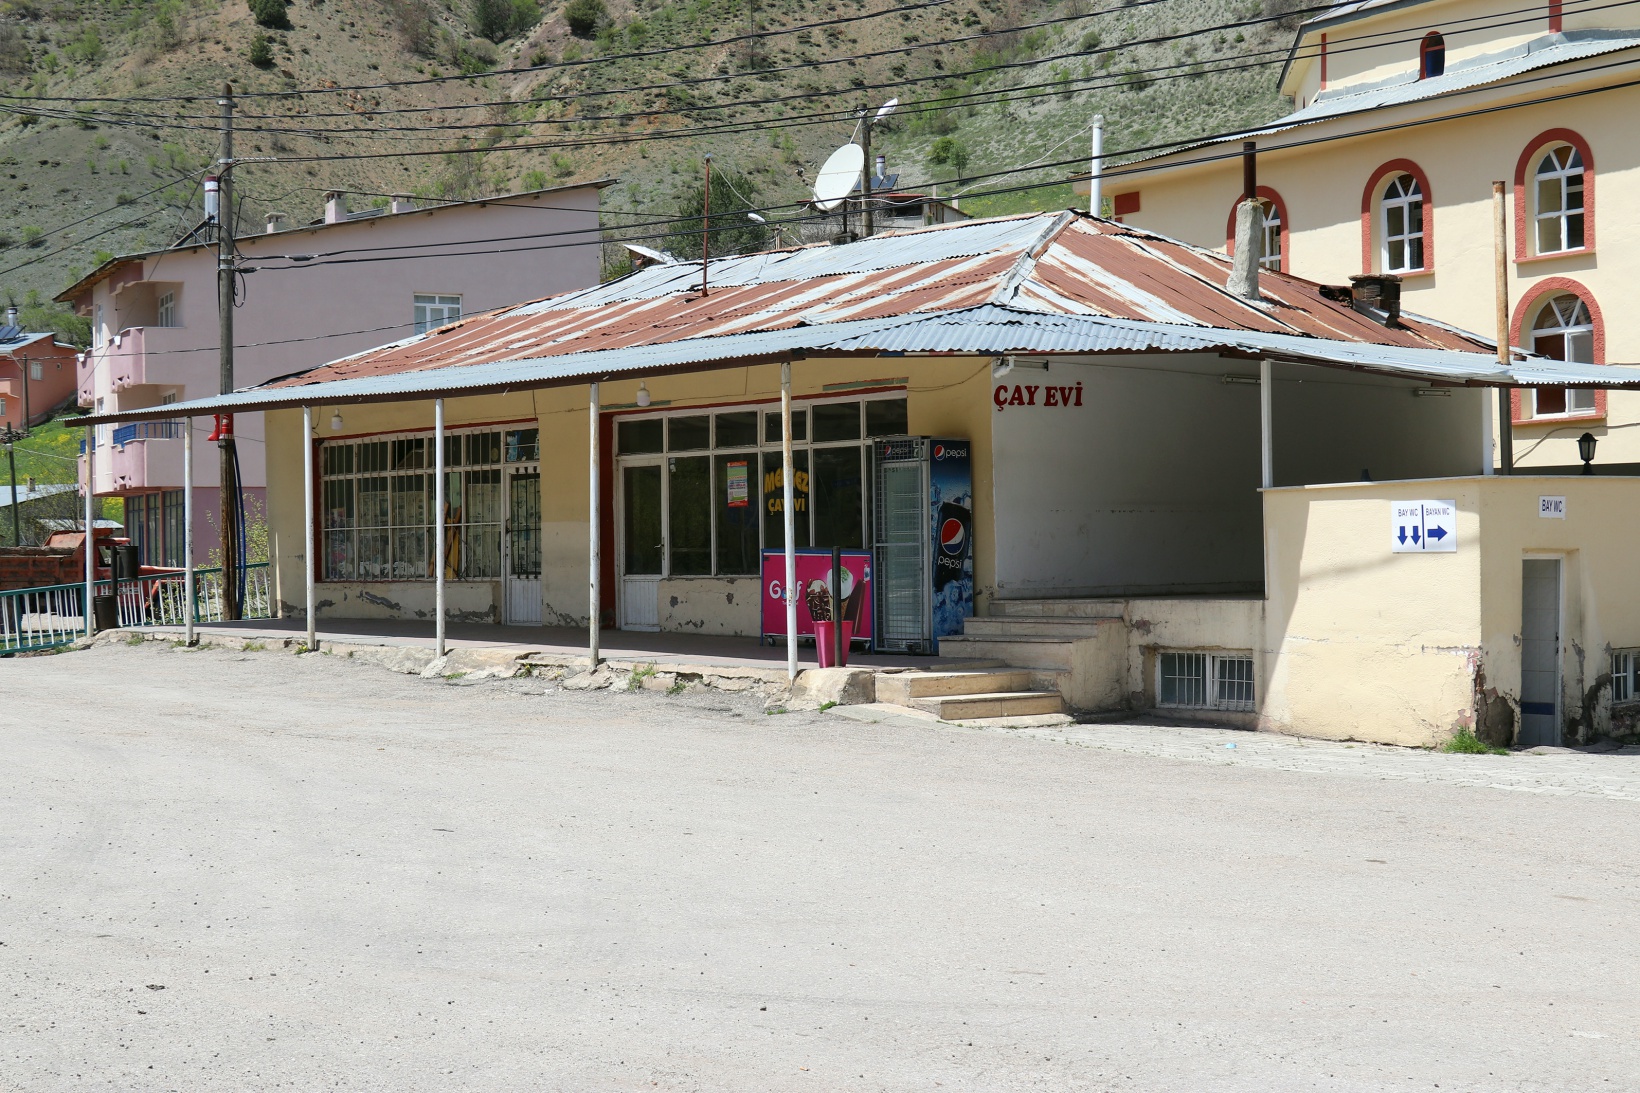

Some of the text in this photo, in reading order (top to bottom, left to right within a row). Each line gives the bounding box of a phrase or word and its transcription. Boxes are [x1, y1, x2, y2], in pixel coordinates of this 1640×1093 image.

[993, 381, 1083, 412] ÇAY EVİ
[945, 448, 967, 459] pepsi
[764, 467, 809, 494] MEEZ
[1397, 508, 1419, 517] BAY WC
[1425, 507, 1450, 516] BAYAN WC
[1542, 499, 1563, 513] BAY WC
[937, 555, 962, 569] pepsi
[769, 579, 803, 601] Gof
